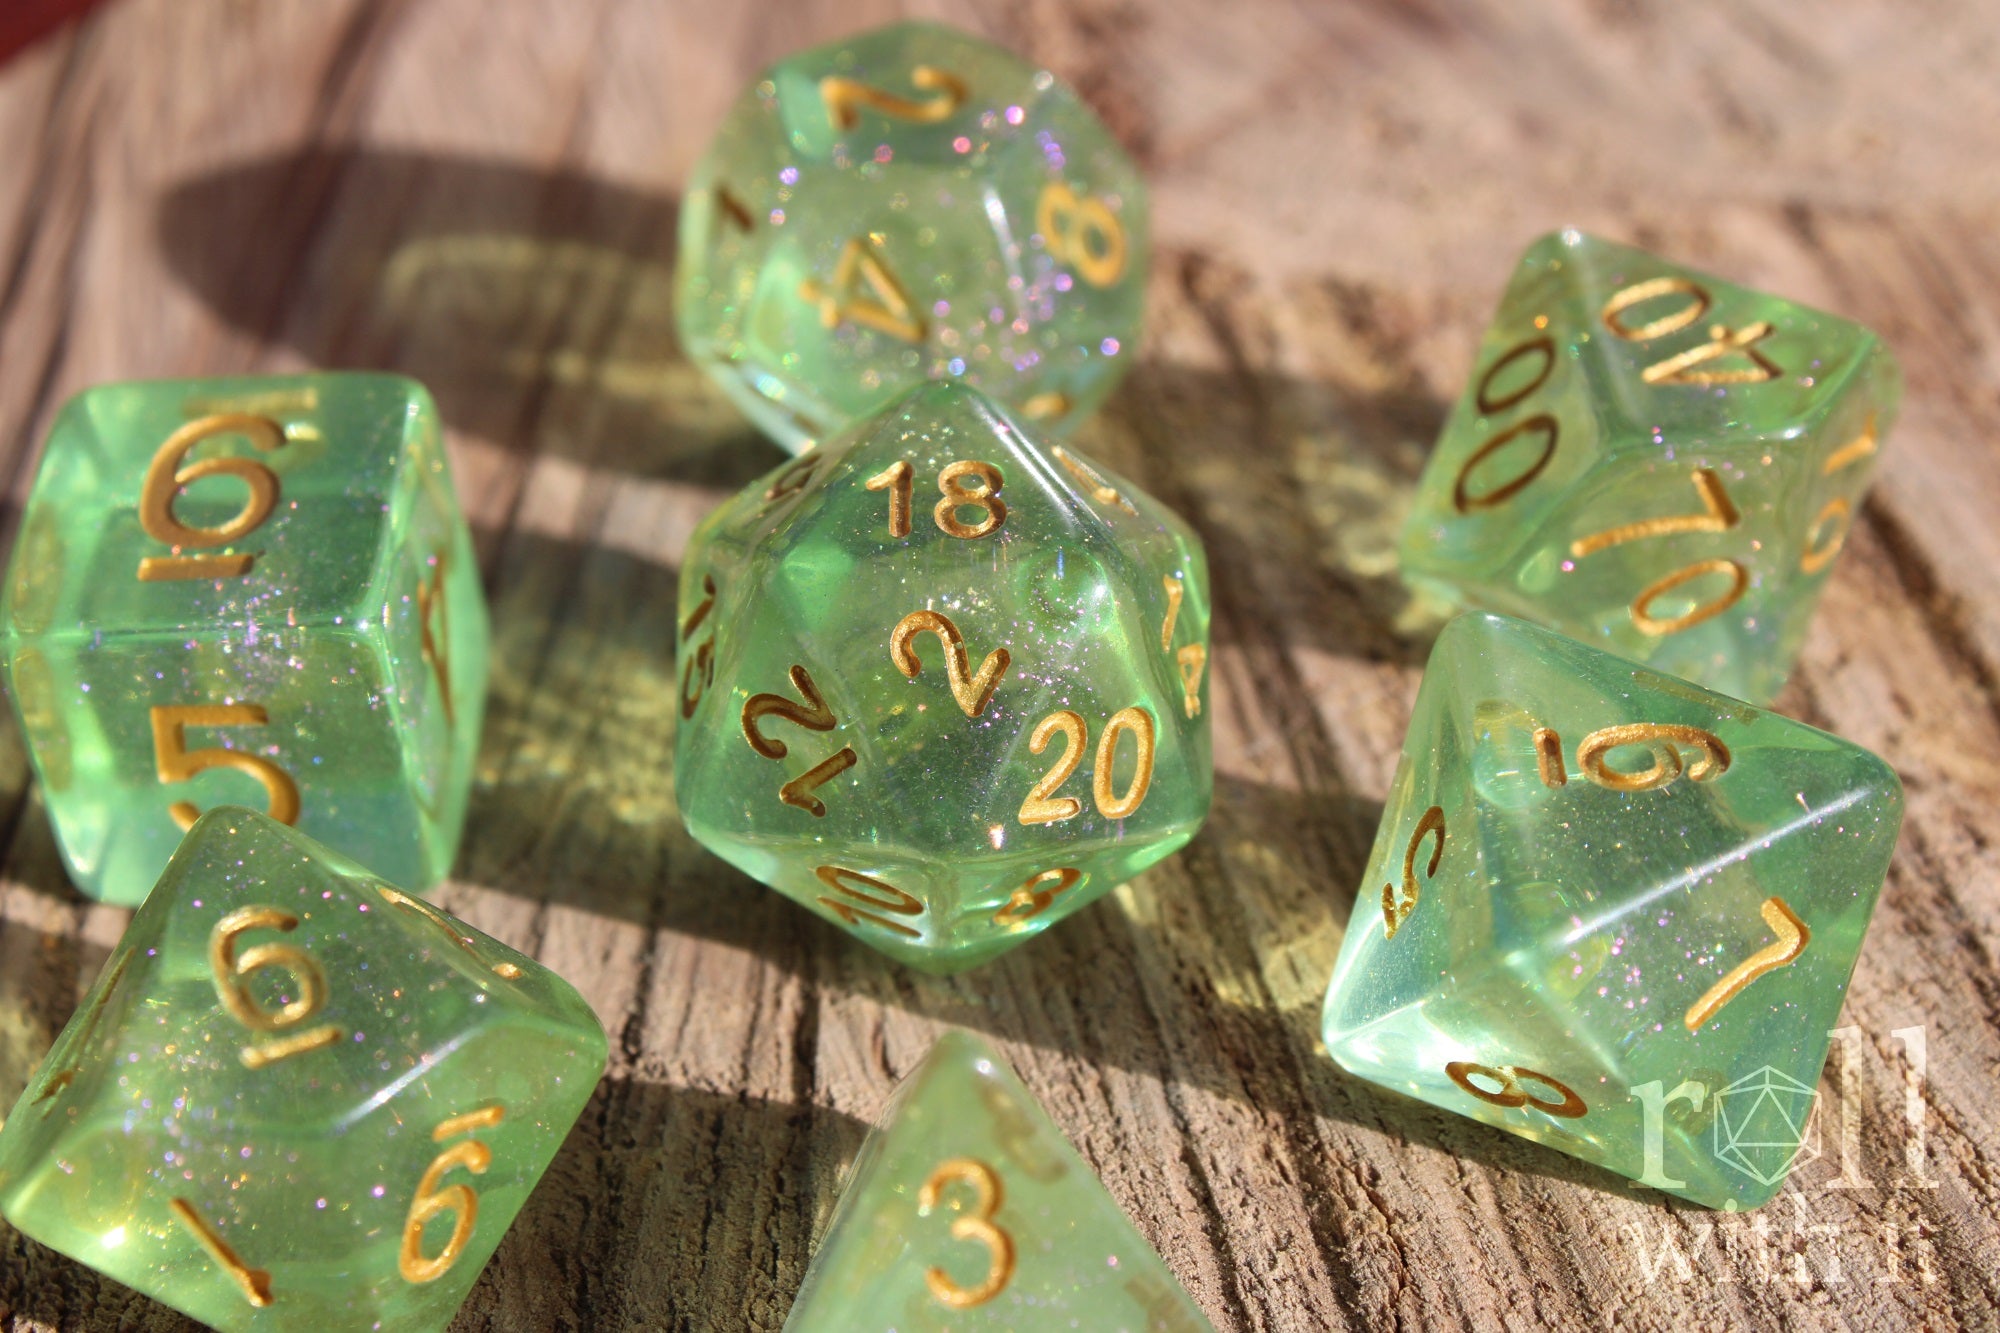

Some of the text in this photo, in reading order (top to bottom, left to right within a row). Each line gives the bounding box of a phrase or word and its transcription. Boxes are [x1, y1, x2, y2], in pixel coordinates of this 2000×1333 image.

[800, 240, 928, 341] 4
[1036, 182, 1127, 287] 8
[1454, 337, 1559, 514] 00
[137, 413, 287, 580] 6
[866, 460, 1008, 539] 18
[890, 610, 1011, 717] 2
[150, 704, 301, 832] 5
[741, 664, 857, 817] 12
[1018, 706, 1156, 824] 20
[992, 867, 1081, 925] 8
[1382, 806, 1445, 940] 5
[209, 905, 341, 1068] 6
[1684, 896, 1811, 1030] 7
[1445, 1060, 1588, 1119] 8
[917, 1158, 1017, 1308] 3
